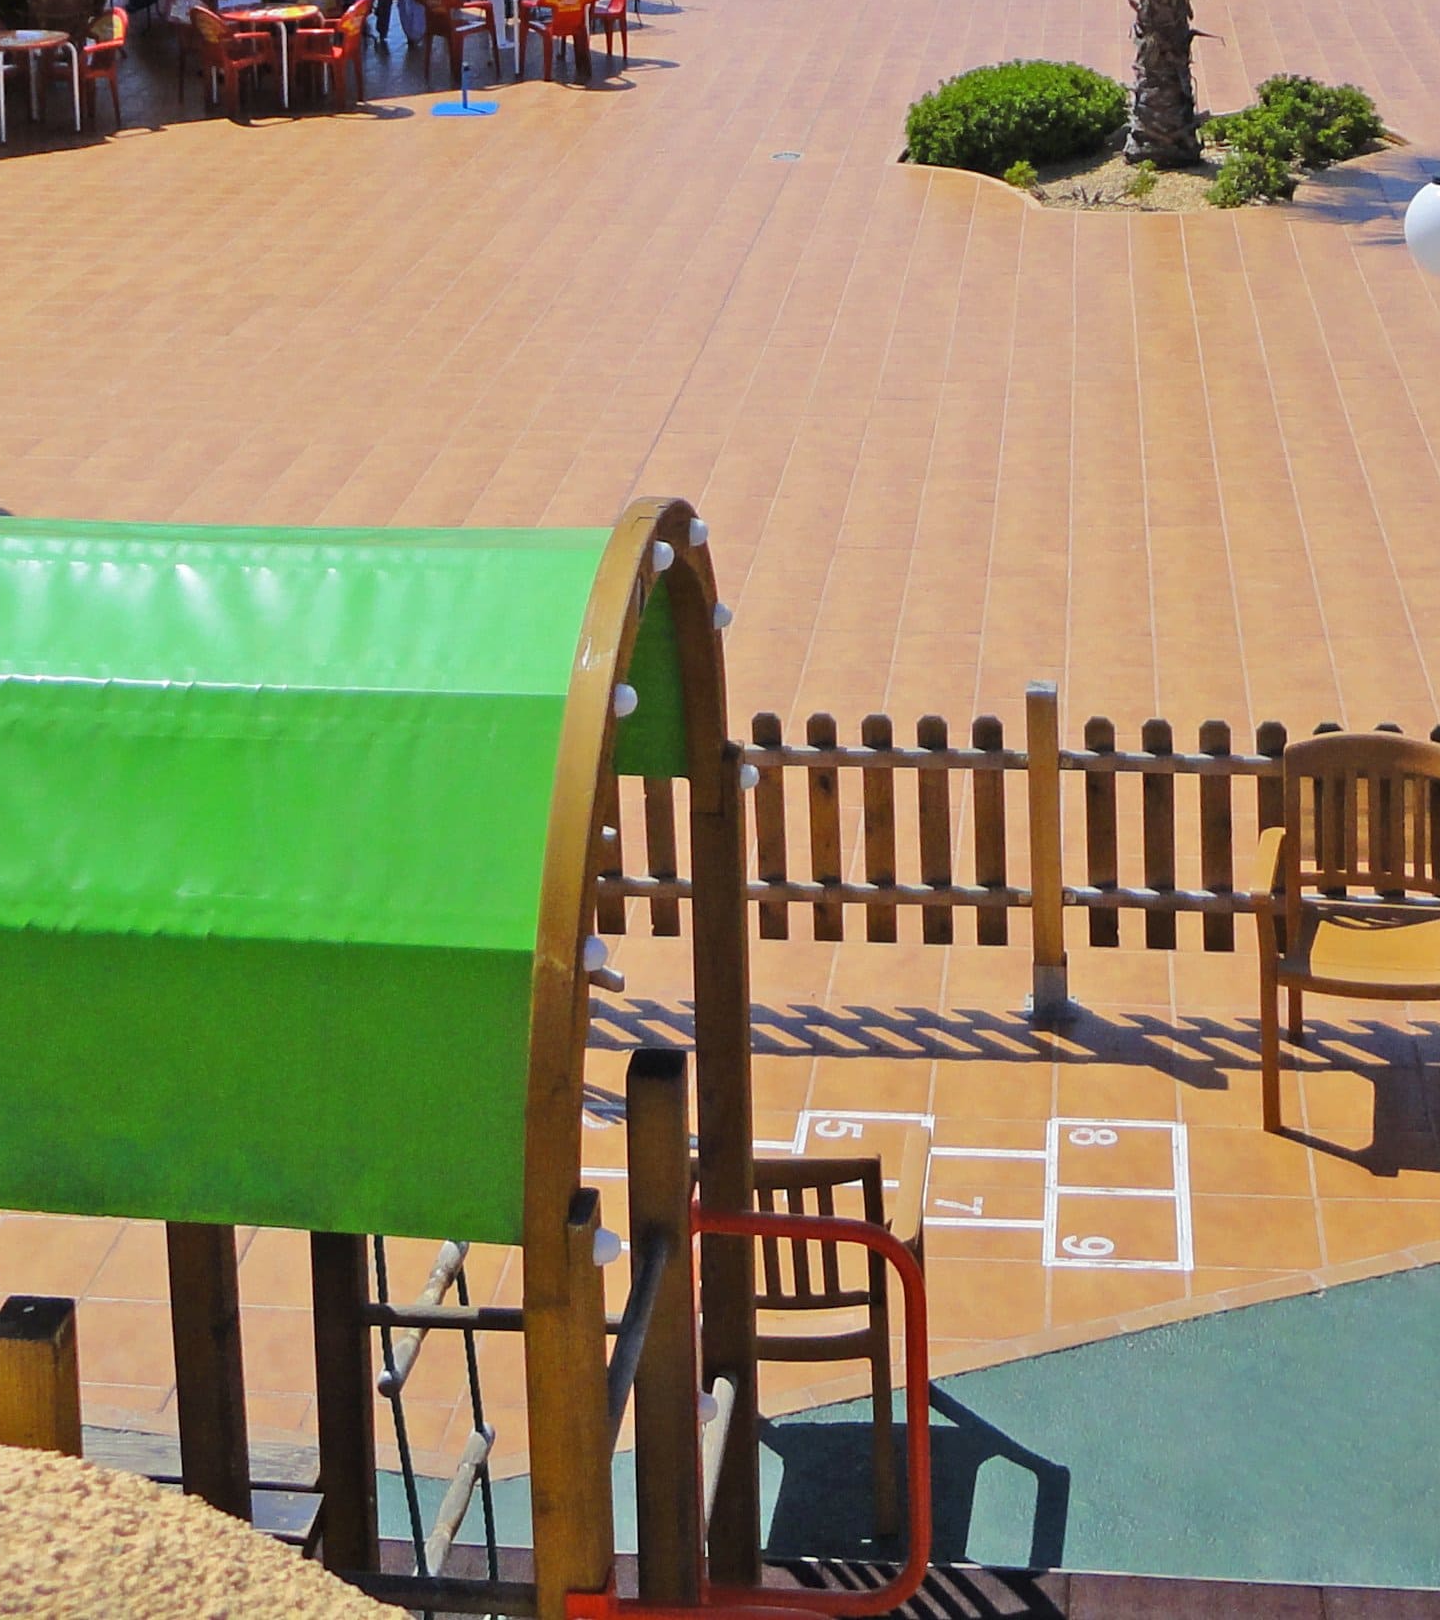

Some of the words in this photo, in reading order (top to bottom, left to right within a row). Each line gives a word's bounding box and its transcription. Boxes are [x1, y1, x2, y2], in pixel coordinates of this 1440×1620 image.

[815, 1119, 863, 1138] 5
[1068, 1127, 1118, 1146] 8
[934, 1196, 984, 1216] 7
